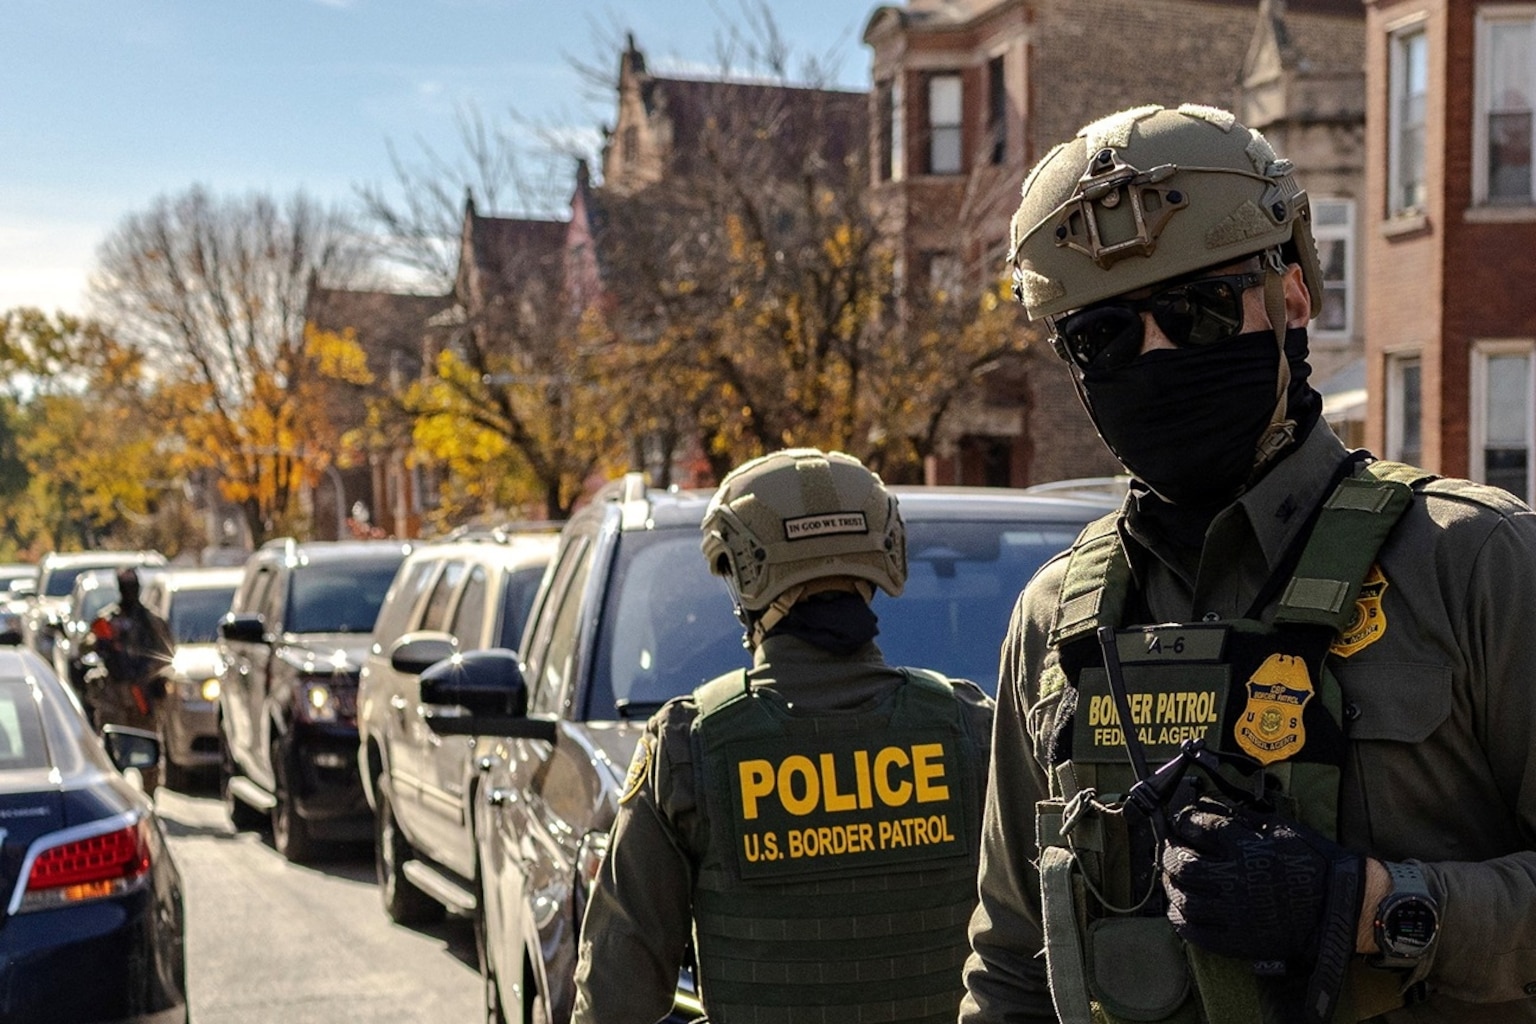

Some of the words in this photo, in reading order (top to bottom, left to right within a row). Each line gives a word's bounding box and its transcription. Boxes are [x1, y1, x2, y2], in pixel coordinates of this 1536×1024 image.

[788, 524, 800, 533] IN
[801, 521, 821, 531] GOD
[822, 519, 838, 528] WE
[838, 517, 863, 527] TRUST
[1147, 636, 1185, 654] A-6
[1089, 694, 1153, 726] BORER
[1156, 692, 1217, 724] PATROL
[1247, 712, 1255, 722] U
[1289, 717, 1297, 729] S
[1094, 728, 1156, 746] FEDAL
[738, 743, 950, 819] POLICE
[743, 830, 783, 862] U.S.
[788, 823, 875, 858] BORDER
[879, 815, 955, 850] PATROL
